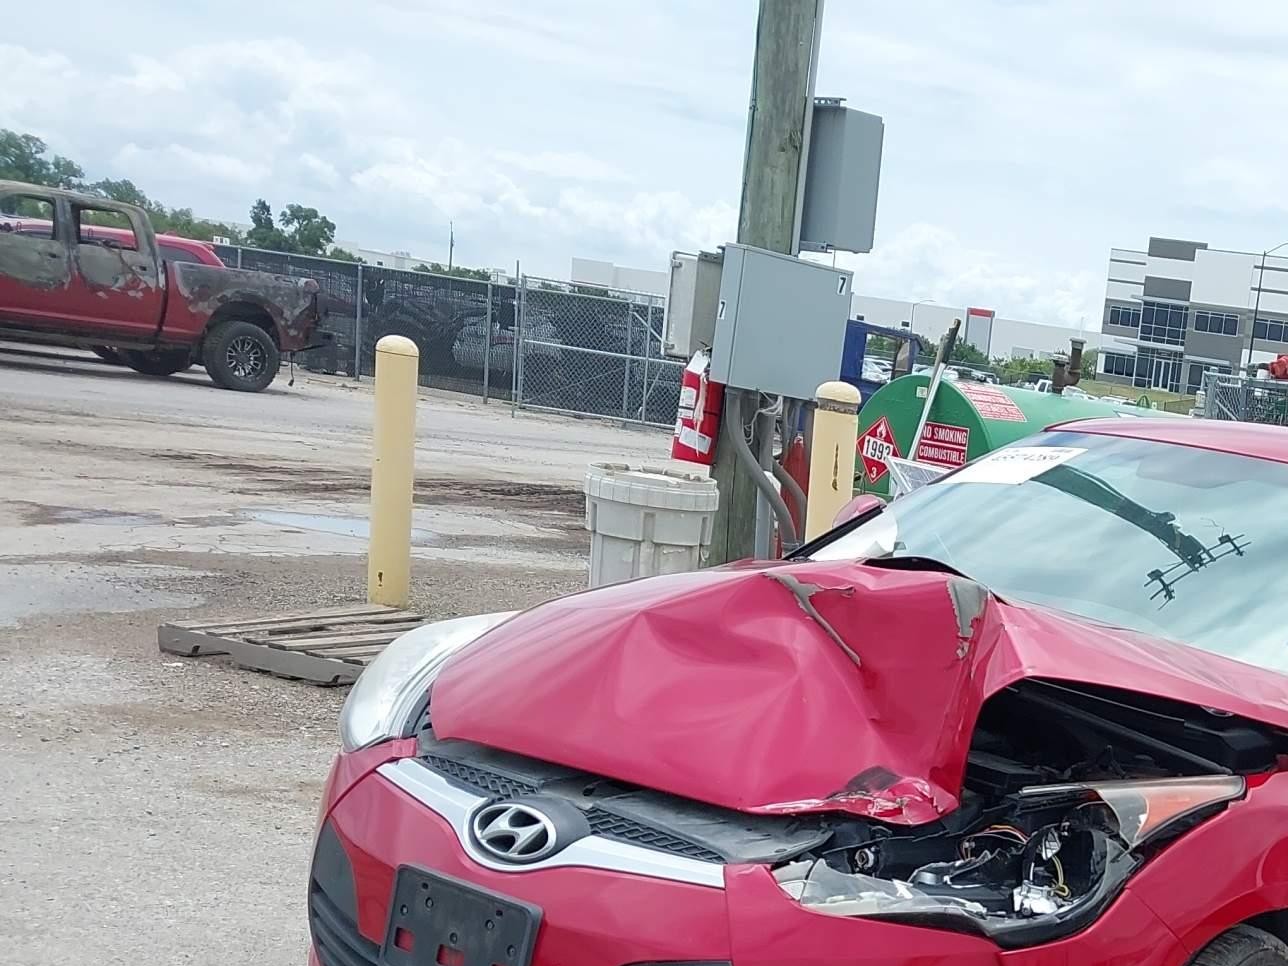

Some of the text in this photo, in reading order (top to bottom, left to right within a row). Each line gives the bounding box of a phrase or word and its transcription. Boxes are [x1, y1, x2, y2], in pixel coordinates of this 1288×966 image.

[839, 277, 847, 294] 7
[719, 301, 726, 318] 7
[933, 426, 967, 444] SMOKING
[919, 446, 965, 464] COMBUSTIBLE
[871, 466, 877, 478] 3
